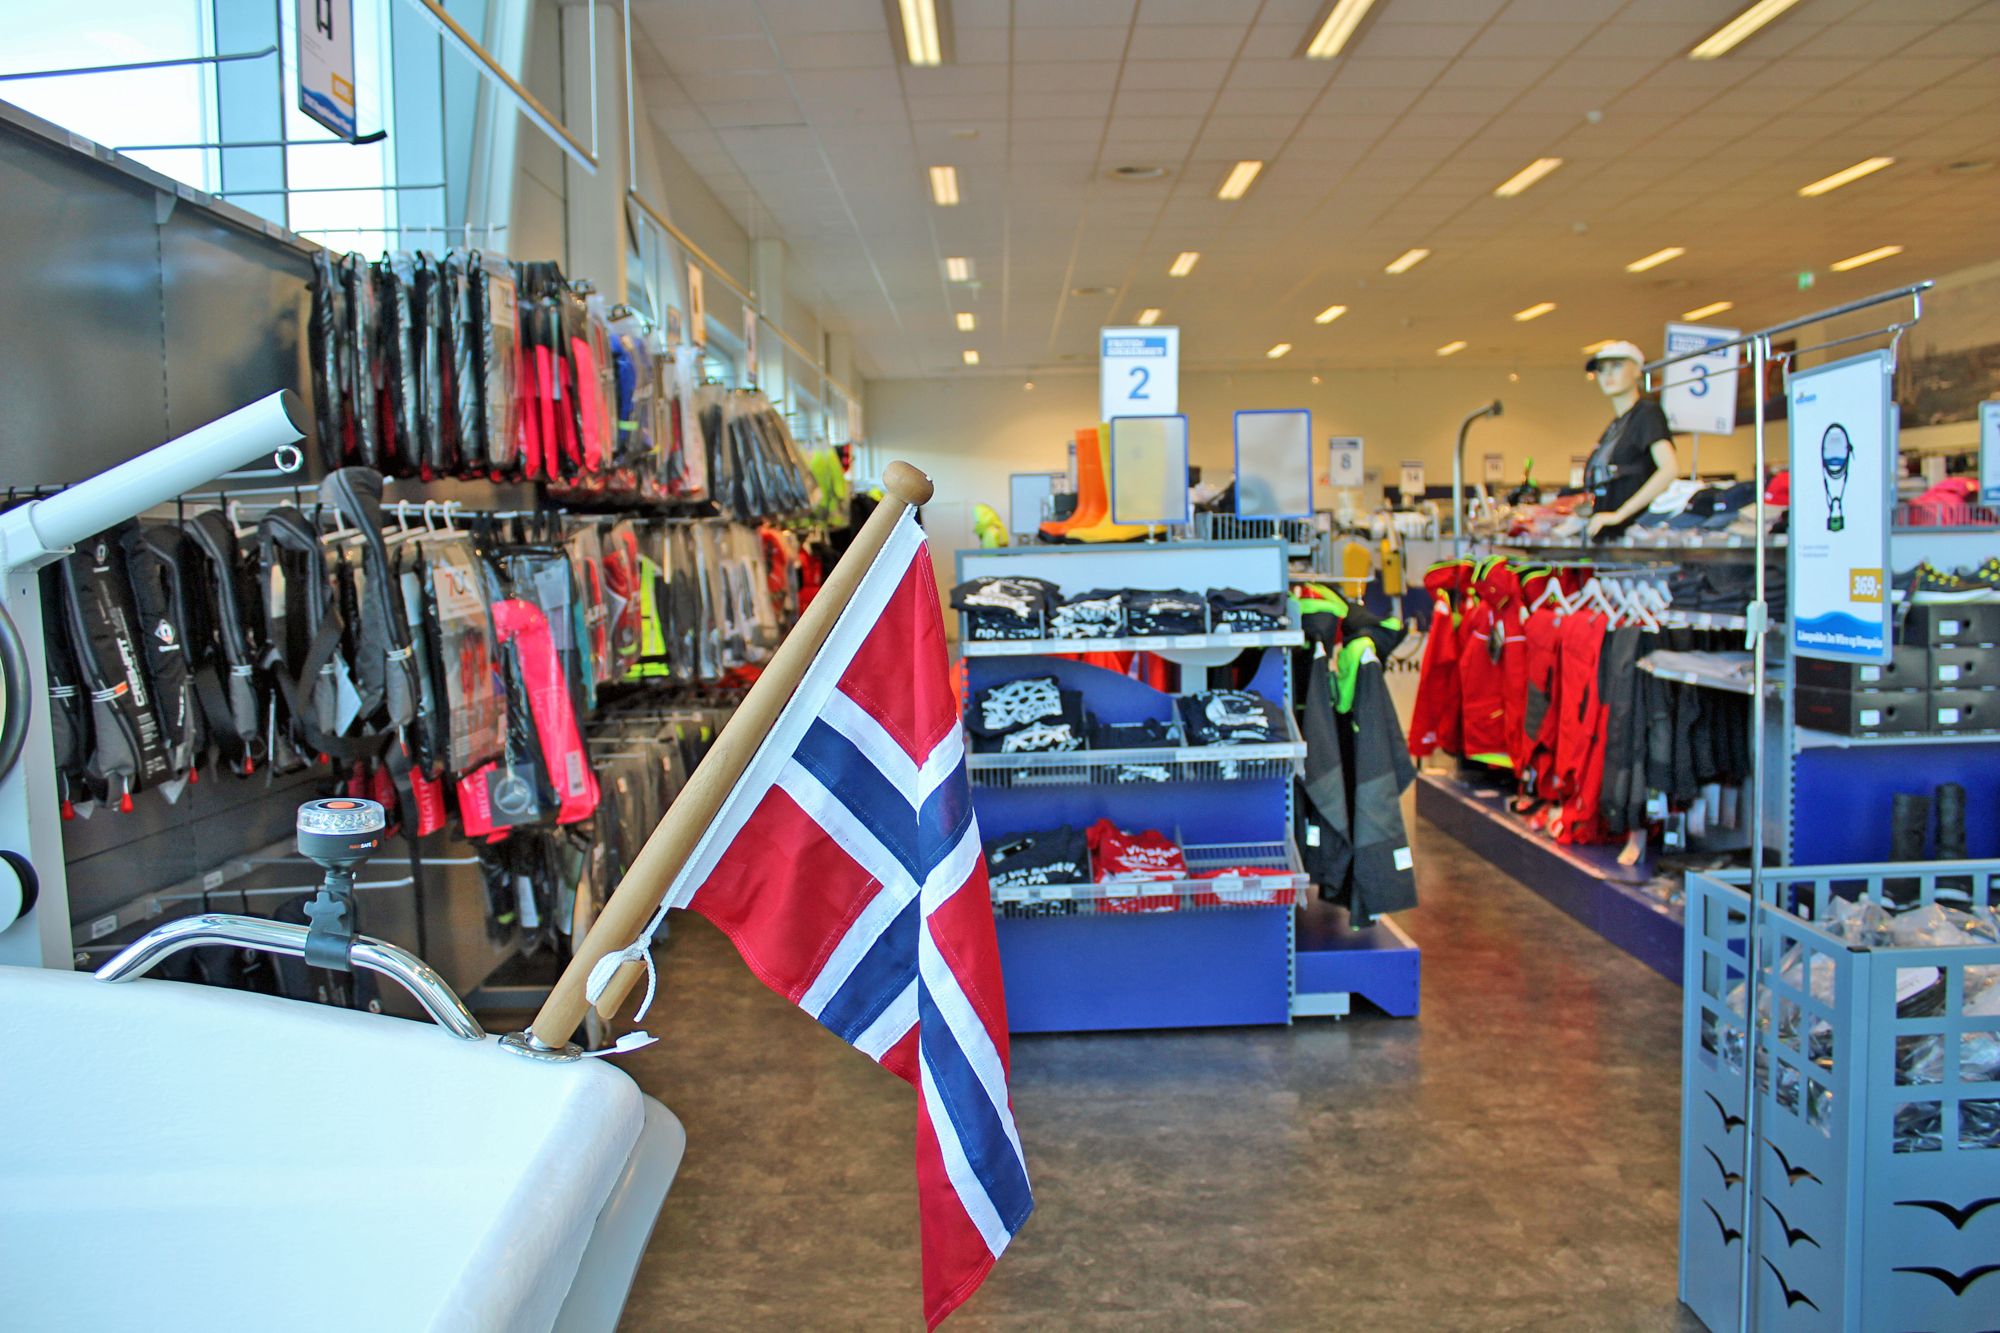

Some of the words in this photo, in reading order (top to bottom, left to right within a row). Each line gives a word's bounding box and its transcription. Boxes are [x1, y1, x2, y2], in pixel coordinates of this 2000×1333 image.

[1128, 366, 1150, 399] 2
[1689, 363, 1709, 397] 3
[116, 637, 146, 707] CREWFIT
